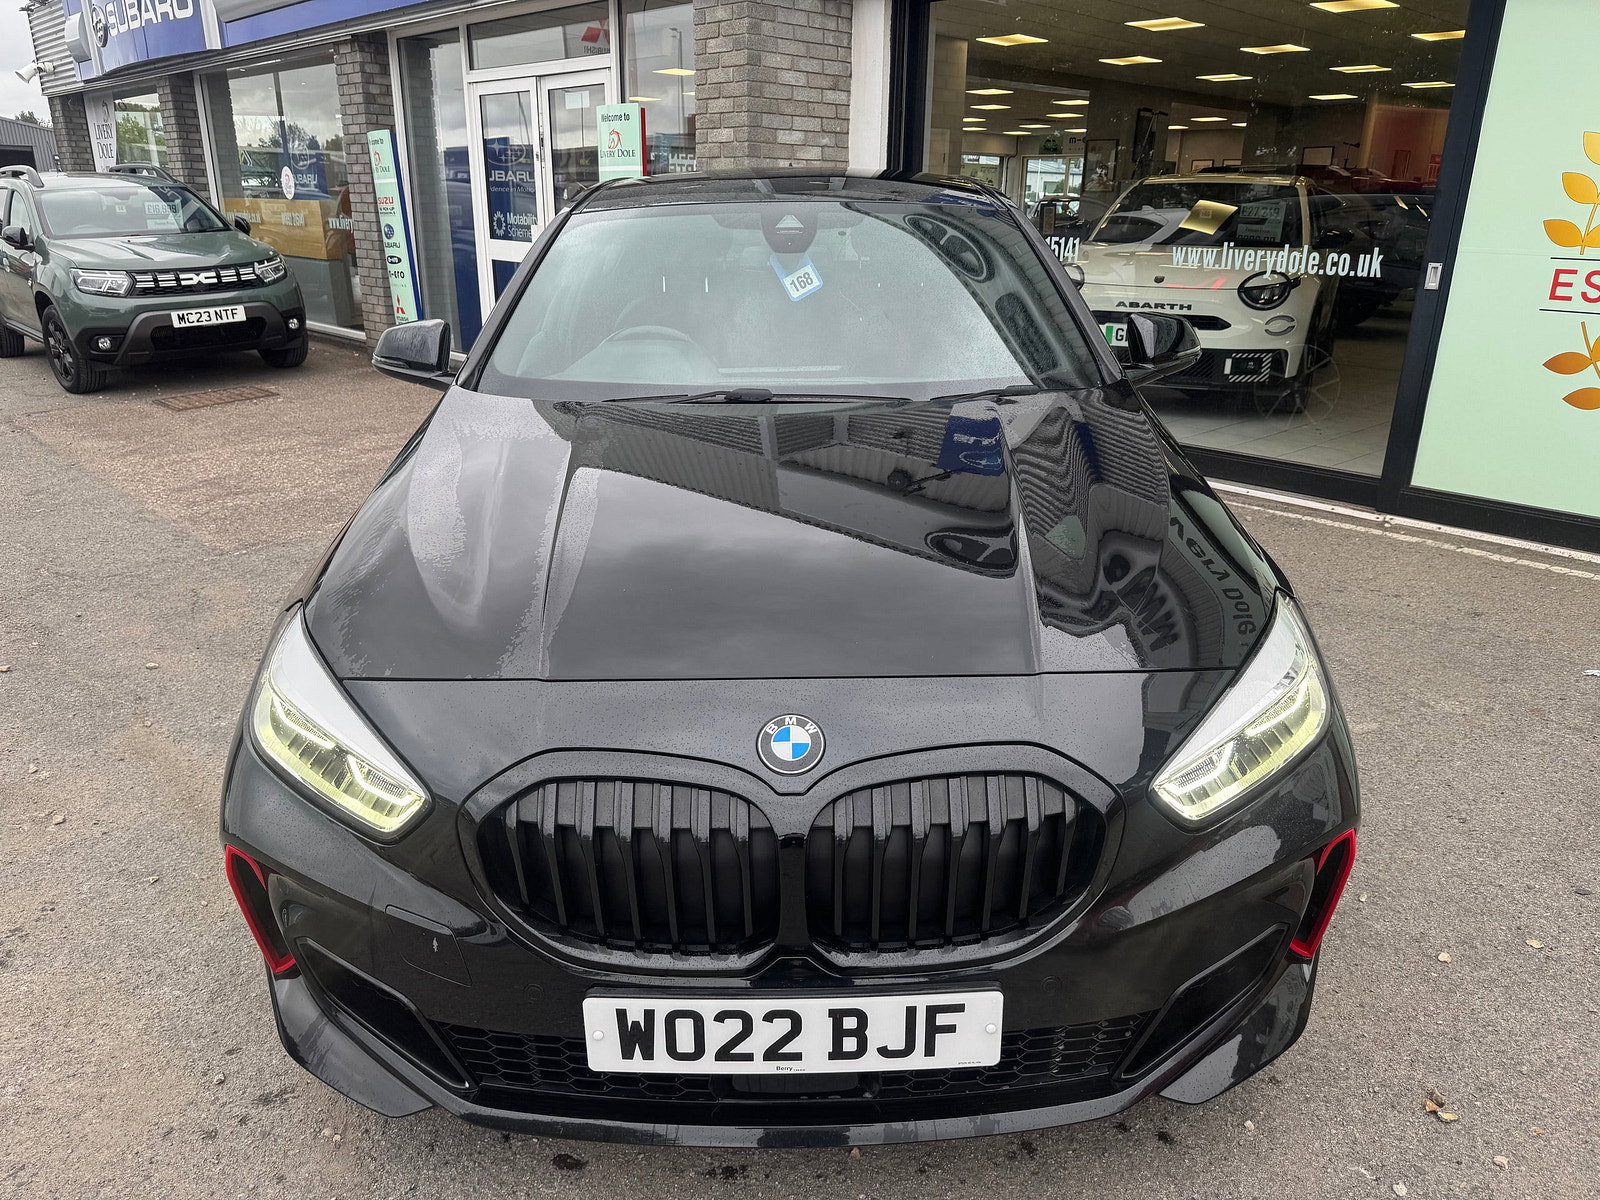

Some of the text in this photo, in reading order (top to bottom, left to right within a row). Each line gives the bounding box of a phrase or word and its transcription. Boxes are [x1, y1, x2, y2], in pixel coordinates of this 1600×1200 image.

[624, 113, 630, 121] to
[617, 149, 636, 158] DOLE
[489, 170, 535, 182] UBARU
[1172, 241, 1385, 278] www.liverydole.co.uk
[790, 272, 814, 292] 168
[1115, 300, 1193, 312] ABARTH
[177, 307, 238, 325] MC23 NTF
[765, 716, 818, 735] BMW
[827, 1003, 966, 1061] BJF
